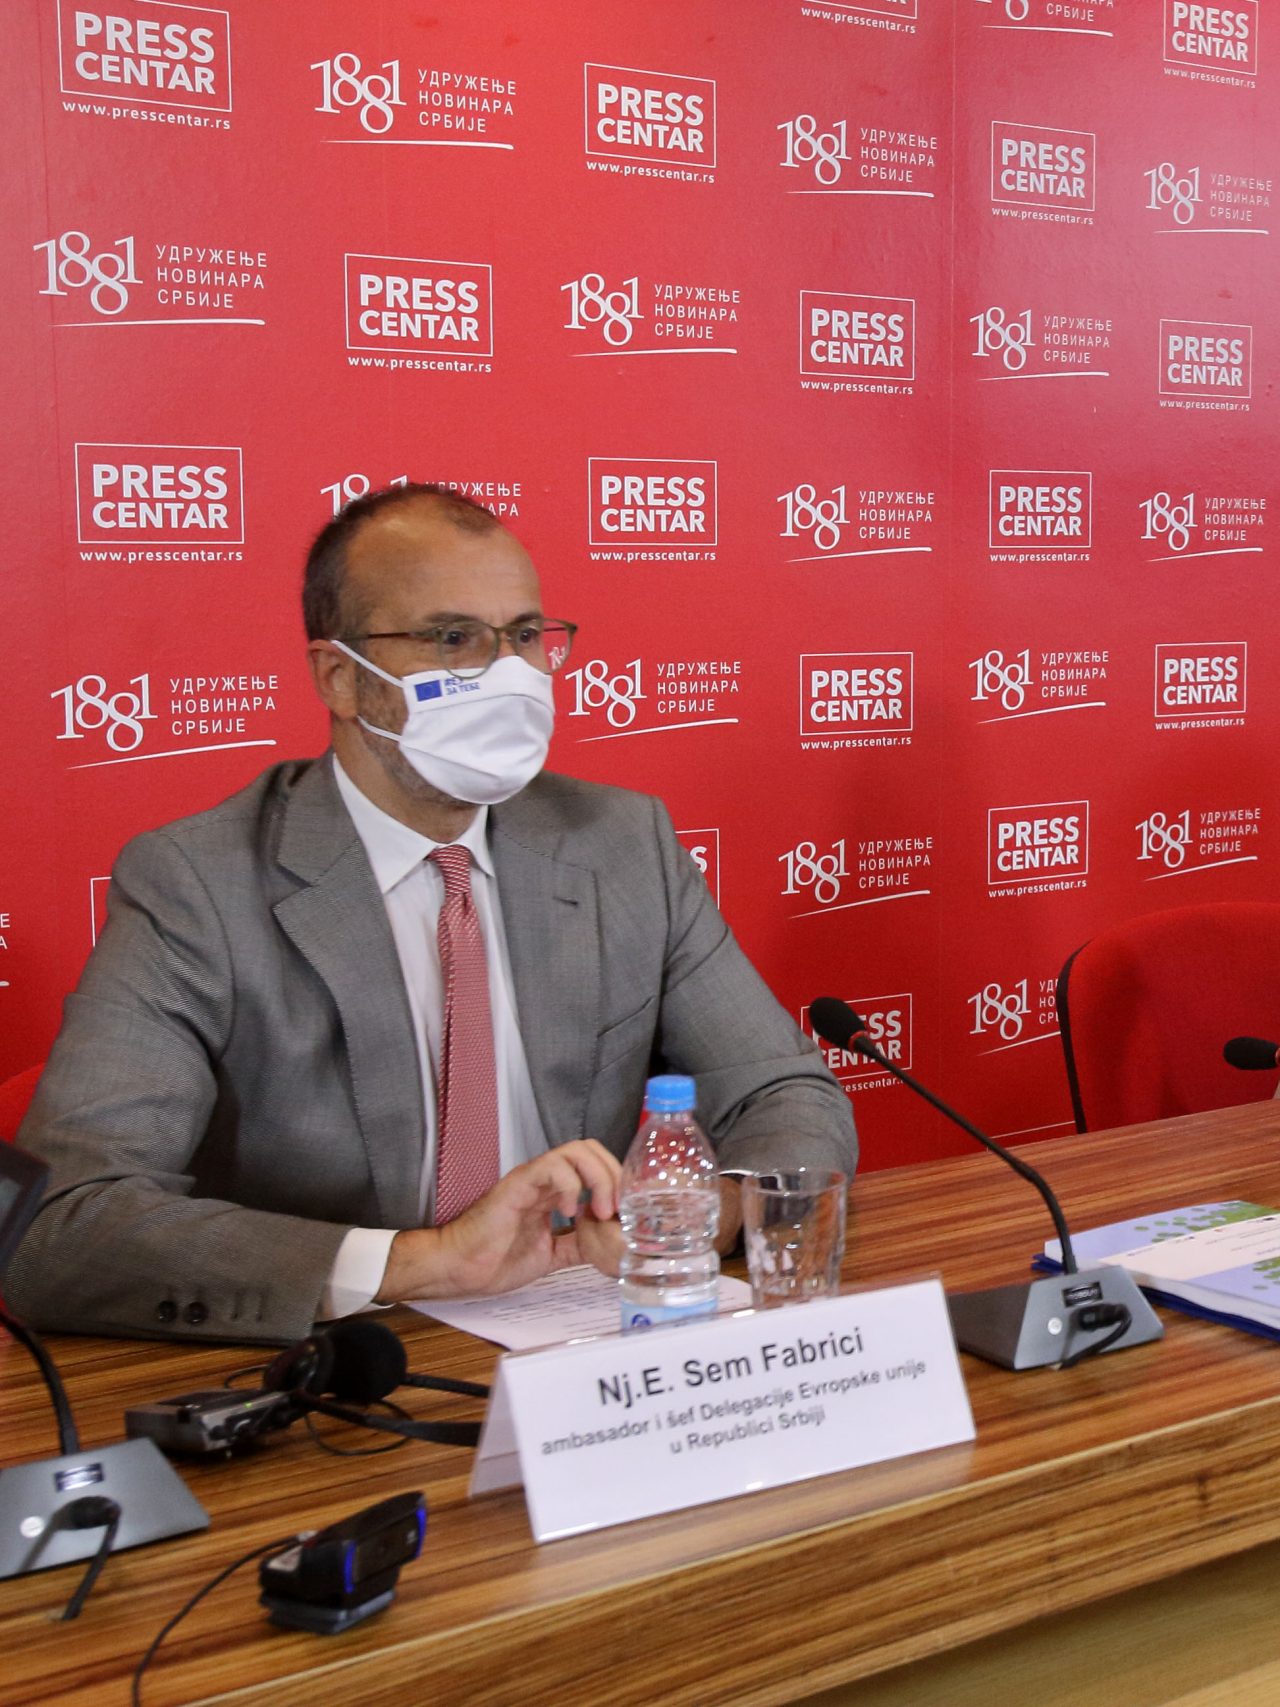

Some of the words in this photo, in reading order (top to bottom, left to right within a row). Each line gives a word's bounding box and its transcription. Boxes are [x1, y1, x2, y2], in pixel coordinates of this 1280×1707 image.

[802, 8, 916, 34] www.presscentar.rs
[1174, 2, 1249, 39] PRESS
[76, 11, 214, 63] PRESS
[1172, 31, 1248, 62] CENTAR
[76, 52, 216, 94] CENTAR
[418, 69, 516, 95] УДРУЖЕЊЕ
[311, 53, 407, 133] 1881
[420, 91, 513, 115] НОВИНАРА
[63, 102, 230, 129] www.presscentar.rs
[598, 83, 704, 126] PRESS
[420, 112, 486, 133] СРБИЈЕ
[597, 118, 704, 153] CENTAR
[861, 128, 937, 149] УДРУЖЕЊЕ
[777, 115, 852, 185] 1881
[861, 146, 935, 167] НОВИНАРА
[1002, 139, 1085, 174] PRESS
[587, 162, 714, 183] www.presscentar.rs
[861, 165, 913, 183] СРБИЈЕ
[1001, 169, 1085, 198] CENTAR
[1144, 163, 1203, 224] 1881
[992, 208, 1093, 225] www.presscentar.rs
[156, 245, 267, 267] УДРУЖЕЊЕ
[33, 231, 143, 315] 1881
[158, 267, 264, 289] НОВИНАРА
[158, 289, 233, 308] СРБИЈЕ
[360, 274, 478, 314] PRESS
[655, 284, 740, 303] УДРУЖЕЊЕ
[561, 273, 644, 346] 1881
[655, 304, 737, 322] НОВИНАРА
[360, 310, 479, 341] CENTAR
[655, 323, 713, 339] СРБИЈЕ
[812, 308, 904, 342] PRESS
[1045, 316, 1112, 332] УДРУЖЕЊЕ
[970, 307, 1036, 370] 1881
[1045, 333, 1110, 347] НОВИНАРА
[1169, 335, 1243, 364] PRESS
[811, 340, 904, 367] CENTAR
[1044, 350, 1090, 364] СРБИЈЕ
[348, 357, 491, 373] www.presscentar.rs
[1168, 363, 1242, 386] CENTAR
[801, 381, 913, 395] www.presscentar.rs
[1160, 400, 1250, 411] www.presscentar.rs
[93, 464, 227, 500] PRESS
[602, 476, 705, 507] PRESS
[860, 491, 934, 505] УДРУЖЕЊЕ
[1000, 486, 1082, 513] PRESS
[1206, 498, 1266, 510] УДРУЖЕЊЕ
[93, 502, 229, 528] CENTAR
[601, 509, 705, 532] CENTAR
[777, 484, 850, 550] 1881
[860, 509, 932, 522] НОВИНАРА
[999, 515, 1082, 536] CENTAR
[1139, 492, 1198, 551] 1881
[1205, 514, 1264, 525] НОВИНАРА
[860, 527, 910, 539] СРБИЈЕ
[1205, 530, 1246, 541] СРБИЈЕ
[80, 550, 243, 564] www.presscentar.rs
[590, 551, 716, 563] www.presscentar.rs
[990, 553, 1090, 563] www.presscentar.rs
[1042, 651, 1109, 666] УДРУЖЕЊЕ
[1165, 656, 1238, 683] PRESS
[657, 662, 741, 678] УДРУЖЕЊЕ
[969, 649, 1034, 710] 1881
[1042, 668, 1106, 681] НОВИНАРА
[170, 676, 278, 695] УДРУЖЕЊЕ
[560, 648, 647, 727] 1881
[658, 680, 738, 694] НОВИНАРА
[812, 668, 902, 698] PRESS
[1042, 685, 1087, 698] СРБИЈЕ
[172, 697, 275, 714] НОВИНАРА
[1163, 684, 1237, 705] CENTAR
[51, 673, 158, 752] 1881
[658, 699, 715, 713] СРБИЈЕ
[811, 699, 902, 722] CENTAR
[172, 719, 245, 735] СРБИЈЕ
[1156, 718, 1245, 730] www.presscentar.rs
[801, 737, 911, 750] www.presscentar.rs
[1201, 808, 1260, 825] УДРУЖЕЊЕ
[999, 816, 1079, 849] PRESS
[1136, 810, 1193, 868] 1881
[1200, 824, 1258, 839] НОВИНАРА
[859, 837, 932, 855] УДРУЖЕЊЕ
[1200, 841, 1241, 855] СРБИЈЕ
[859, 855, 930, 871] НОВИНАРА
[997, 845, 1079, 871] CENTAR
[779, 839, 850, 903] 1881
[859, 873, 909, 889] СРБИЈЕ
[989, 880, 1087, 898] www.presscentar.rs
[968, 979, 1031, 1040] 1881
[598, 1366, 674, 1408] Nj.E.
[683, 1356, 752, 1387] Sem
[762, 1326, 864, 1371] Fabrici
[541, 1420, 650, 1455] ambasador
[655, 1413, 661, 1430] i
[666, 1406, 695, 1428] šef
[700, 1388, 794, 1420] Delegacije
[799, 1370, 880, 1399] Evropske
[886, 1359, 926, 1380] unije
[670, 1441, 682, 1454] u
[687, 1417, 775, 1450] Republici
[778, 1405, 826, 1429] Srbiji
